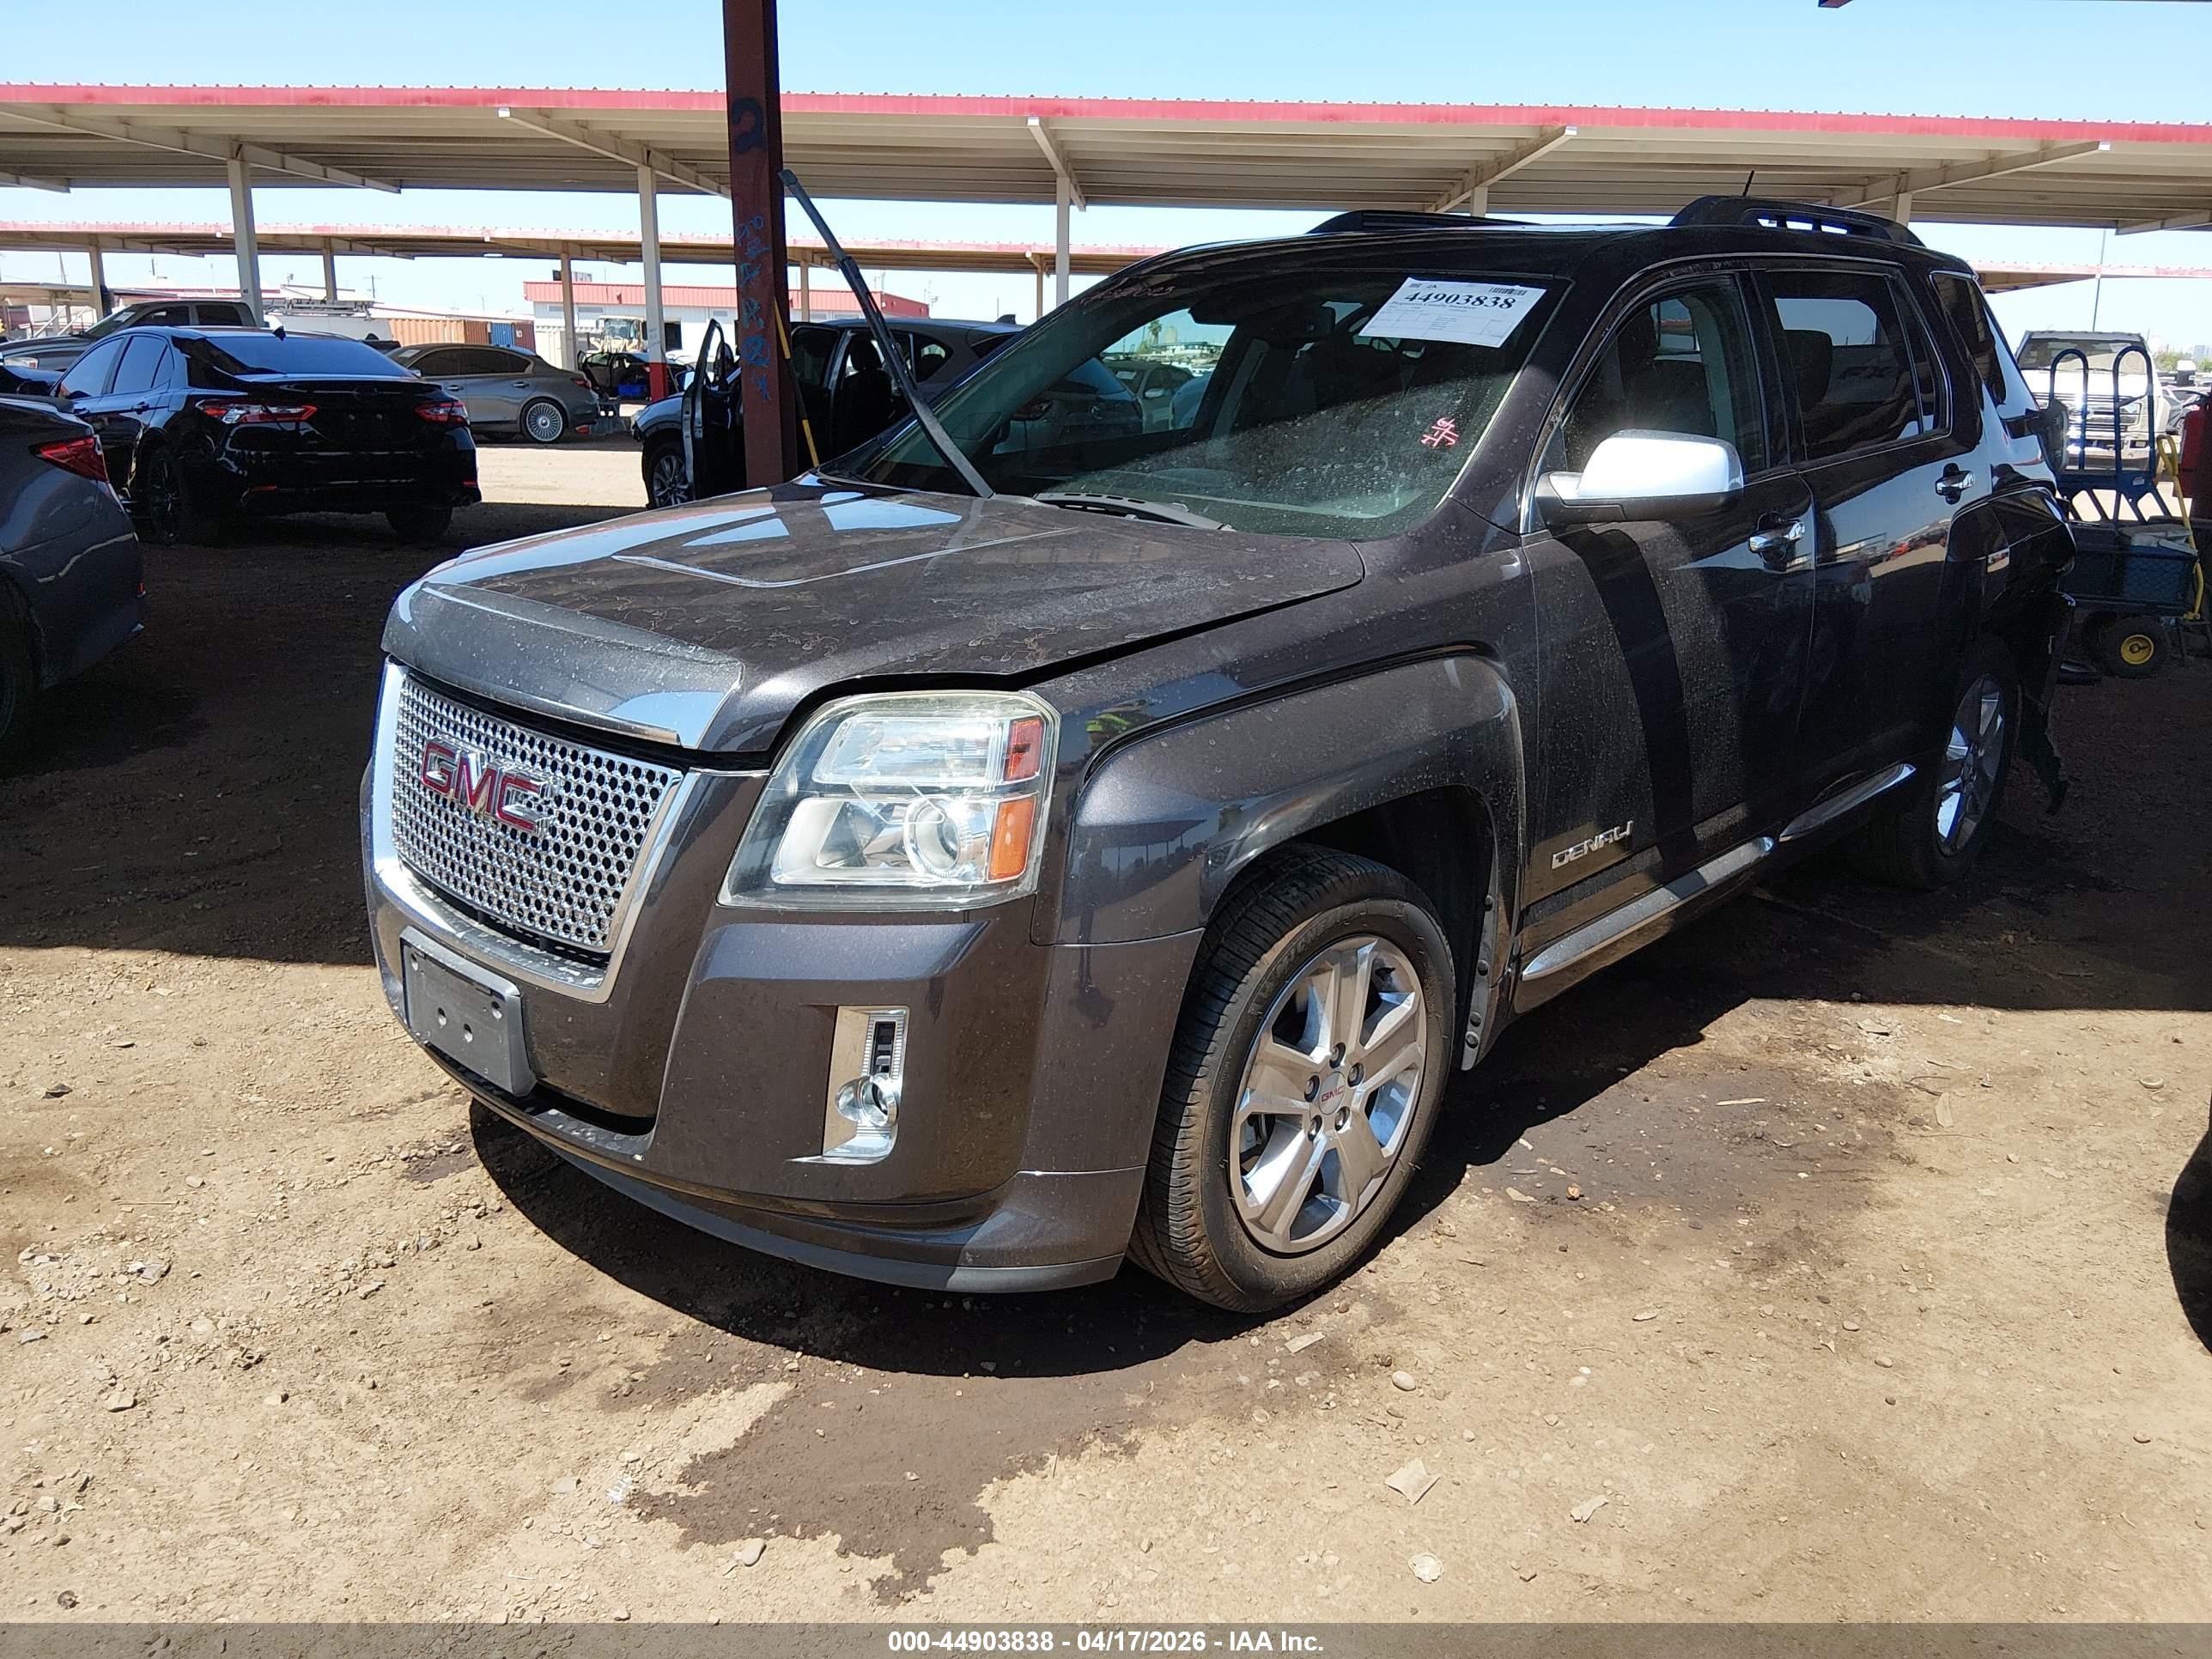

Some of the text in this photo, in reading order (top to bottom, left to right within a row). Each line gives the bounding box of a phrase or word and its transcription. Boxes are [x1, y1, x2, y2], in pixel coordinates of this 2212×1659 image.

[1405, 291, 1516, 310] 44903838
[420, 738, 545, 833] GMC
[1552, 820, 1634, 869] DENALI
[1321, 1085, 1345, 1103] GMC
